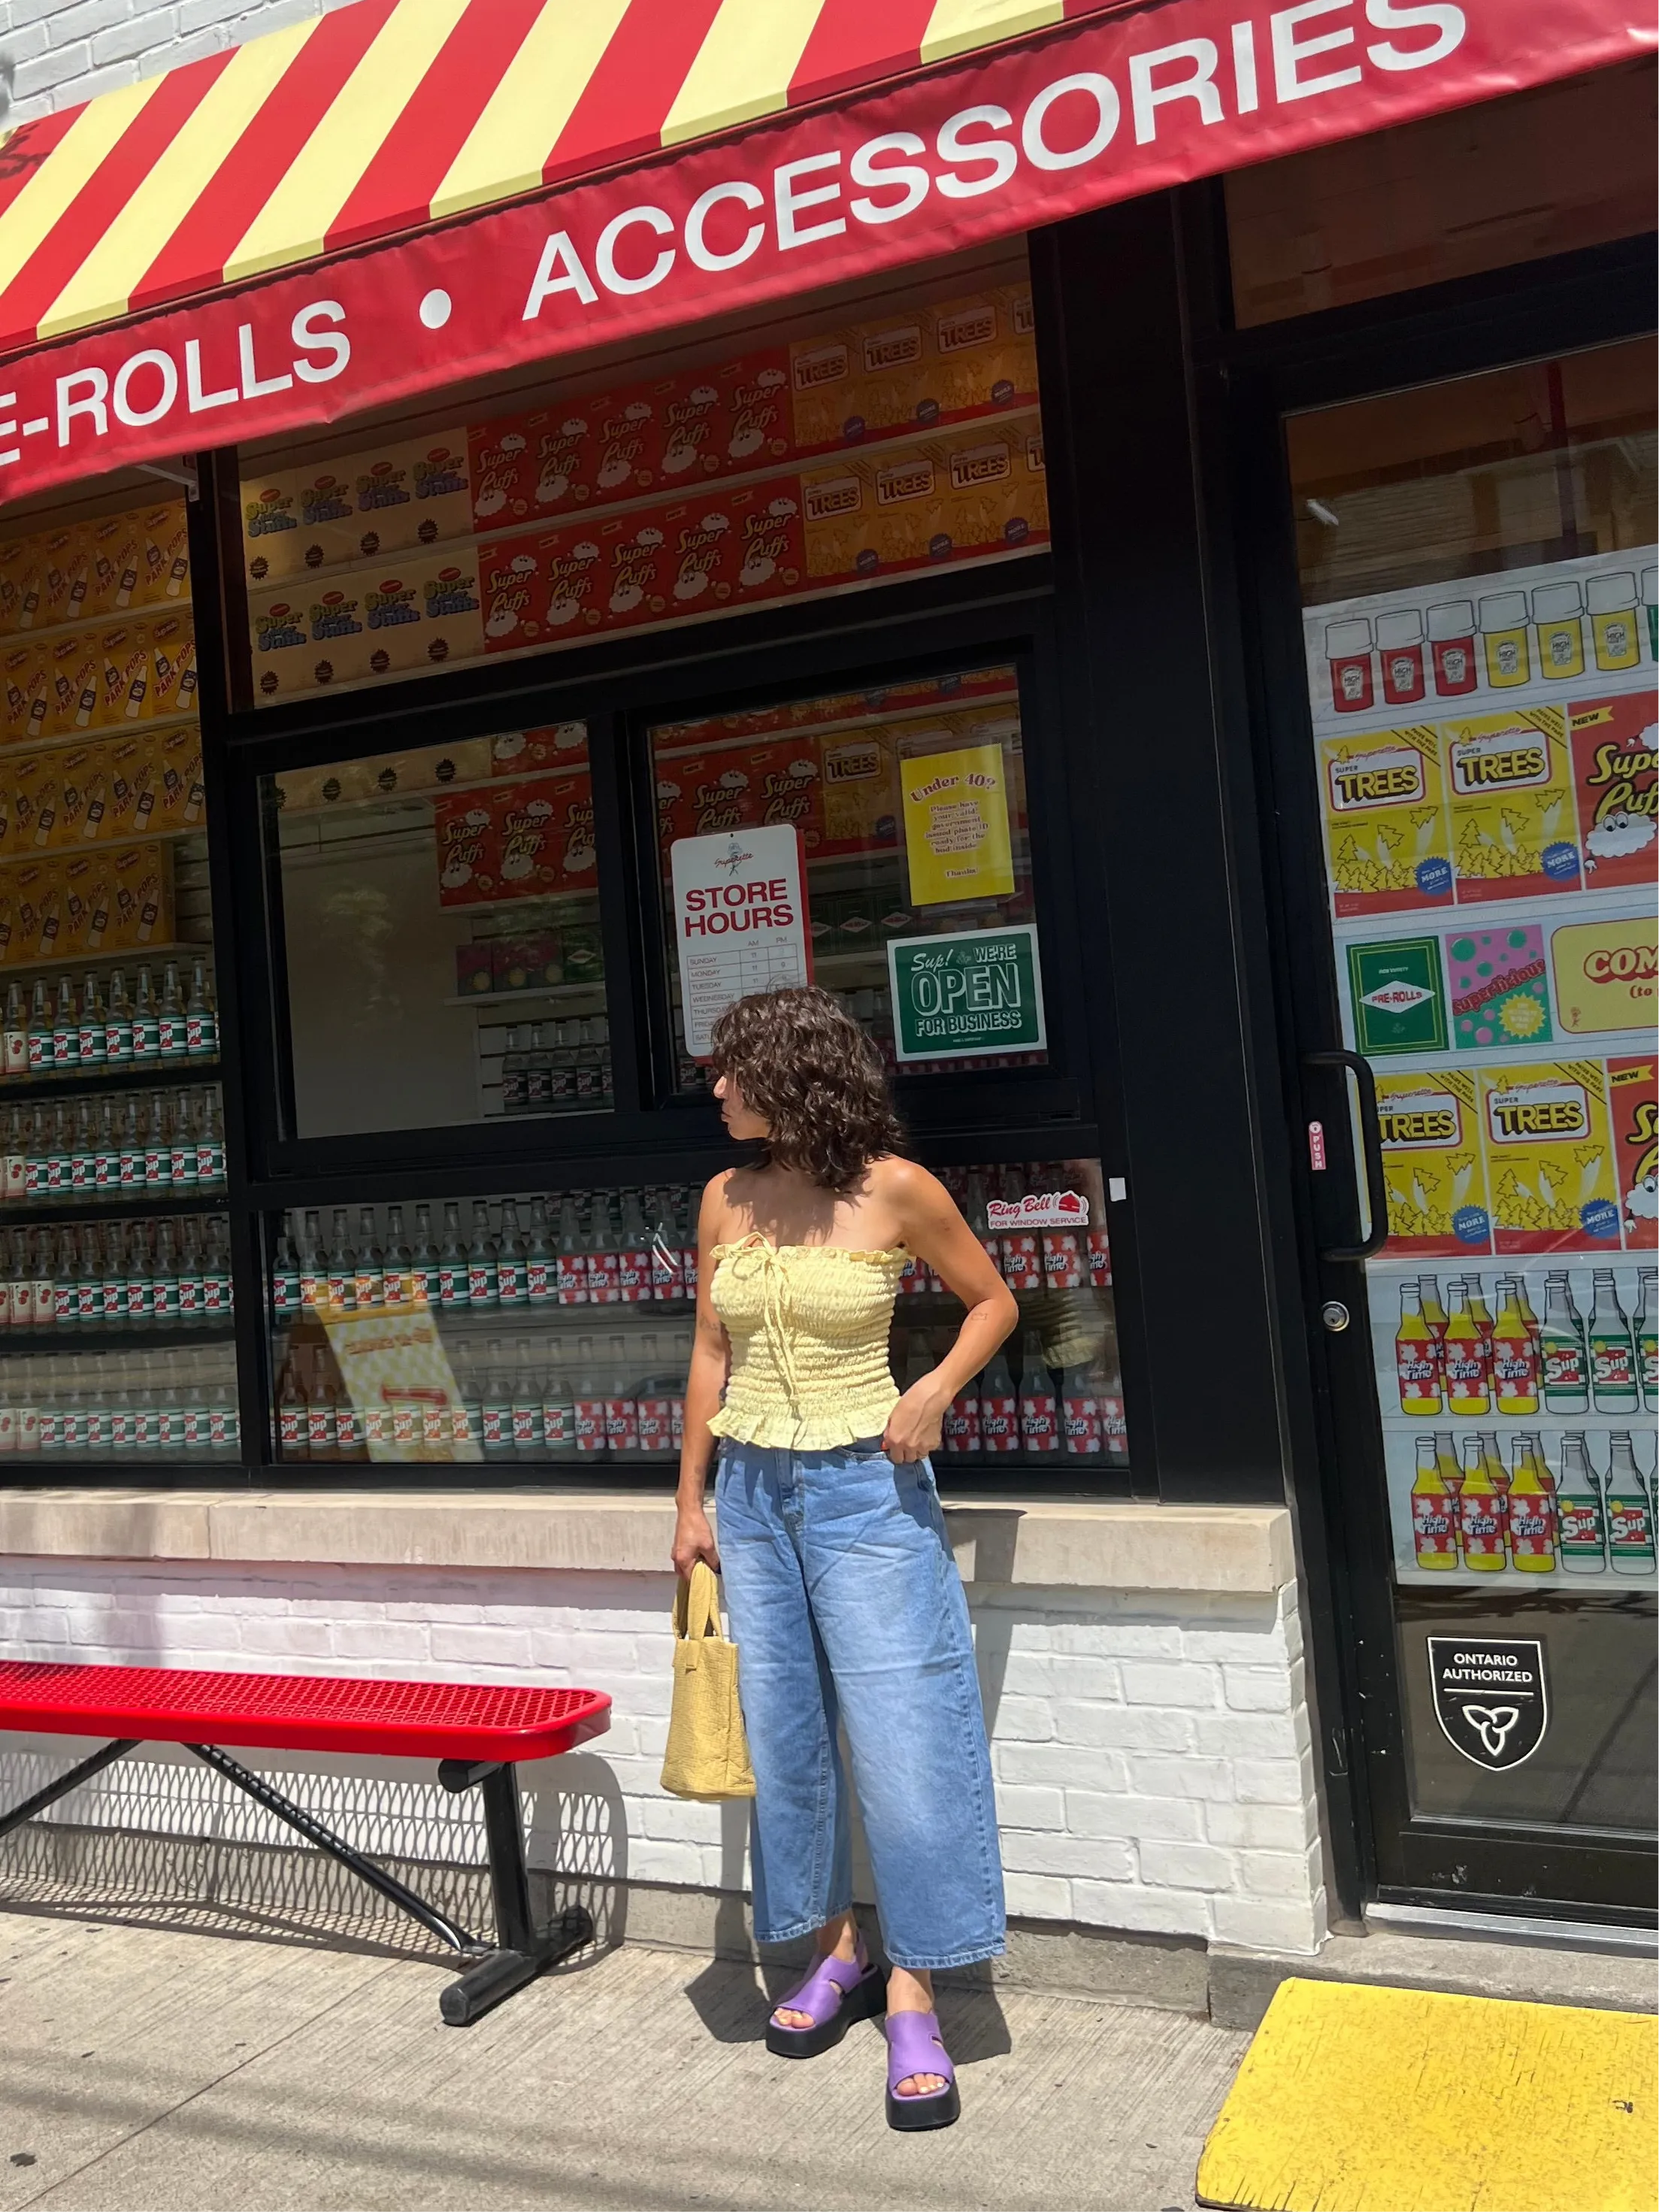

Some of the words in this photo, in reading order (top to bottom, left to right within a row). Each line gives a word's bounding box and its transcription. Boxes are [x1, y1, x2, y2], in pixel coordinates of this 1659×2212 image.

[522, 0, 1467, 321] ACCESSORIES
[940, 320, 992, 347] TREES
[867, 339, 918, 365] TREES
[797, 356, 845, 384] TREES
[728, 384, 781, 412] Super
[662, 401, 713, 428] Super
[731, 404, 779, 439] Puffs
[598, 417, 646, 444] Super
[665, 422, 712, 453] Puffs
[536, 433, 583, 459] Super
[601, 438, 644, 466] Puffs
[475, 449, 522, 474] Super
[539, 453, 581, 486] Puffs
[953, 454, 1007, 483] TREES
[478, 467, 522, 494] Puffs
[880, 471, 931, 499] TREES
[808, 487, 858, 516] TREES
[740, 514, 792, 541] Super
[674, 528, 725, 554] Super
[743, 534, 792, 567] Puffs
[610, 543, 659, 568] Super
[677, 548, 722, 580] Puffs
[487, 568, 533, 594] Super
[547, 556, 595, 581] Super
[613, 563, 658, 594] Puffs
[489, 589, 531, 617] Puffs
[550, 577, 593, 605] Puffs
[1572, 713, 1599, 726] NEW
[828, 753, 879, 778] TREES
[1456, 747, 1545, 786] TREES
[761, 772, 813, 799] Super
[910, 776, 959, 801] Under
[965, 774, 995, 789] 40?
[1335, 765, 1419, 803] TREES
[692, 784, 744, 810] Super
[763, 794, 812, 824] Puffs
[501, 811, 549, 836] Super
[696, 805, 743, 832] Puffs
[931, 817, 980, 830] government
[442, 820, 486, 844] Super
[926, 829, 950, 838] issued
[954, 826, 976, 835] photo
[446, 842, 486, 867] Puffs
[1547, 852, 1575, 868] MORE
[1421, 866, 1448, 883] MORE
[686, 878, 788, 911] STORE
[685, 904, 794, 938] HOURS
[690, 957, 717, 965] SUNDAY
[911, 949, 953, 972] Sup!
[973, 944, 1016, 962] WE'RE
[692, 969, 720, 977] MONDAY
[692, 982, 722, 990] TUESDAY
[693, 993, 734, 1003] WEDNESDAY
[911, 962, 1021, 1016] OPEN
[1371, 990, 1422, 1004] PRE-ROLLS
[1630, 985, 1652, 998] (to
[916, 1018, 946, 1036] FOR
[947, 1010, 1022, 1034] BUSINESS
[1612, 1071, 1639, 1083] NEW
[1378, 1110, 1456, 1142] TREES
[1494, 1101, 1584, 1135] TREES
[1313, 1136, 1322, 1168] PUSH
[988, 1203, 1020, 1218] Ring
[1023, 1196, 1051, 1212] Bell
[1586, 1211, 1615, 1226] MORE
[1049, 1217, 1087, 1225] SERVICE
[1407, 1369, 1432, 1380] Time
[1408, 1361, 1431, 1370] High
[1454, 1369, 1479, 1379] Time
[1455, 1359, 1479, 1370] High
[1503, 1359, 1527, 1370] High
[1503, 1368, 1528, 1379] Time
[1545, 1357, 1579, 1380] Sup
[1594, 1356, 1628, 1379] Sup
[1422, 1516, 1446, 1526] High
[1422, 1526, 1448, 1535] Time
[1470, 1516, 1494, 1527] High
[1470, 1526, 1497, 1535] Time
[1518, 1526, 1544, 1536] Time
[1519, 1516, 1542, 1527] High
[1561, 1517, 1595, 1539] Sup
[1610, 1517, 1645, 1540] Sup
[1453, 1653, 1518, 1666] ONTARIO
[1443, 1668, 1533, 1683] AUTHORIZED
